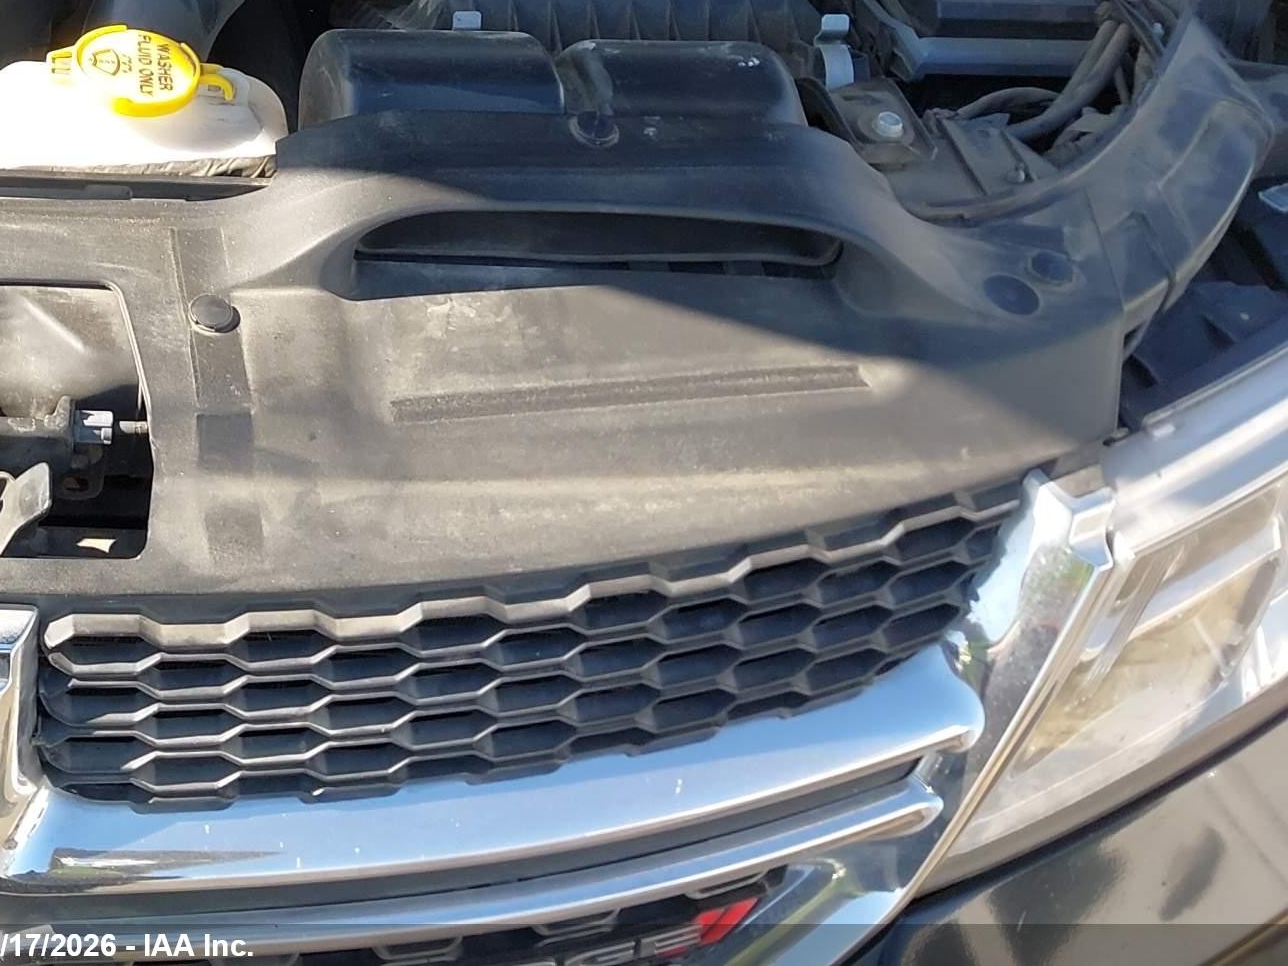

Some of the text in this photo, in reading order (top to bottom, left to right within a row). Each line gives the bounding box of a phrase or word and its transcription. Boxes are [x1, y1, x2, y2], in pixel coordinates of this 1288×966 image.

[138, 34, 154, 98] FLUID ONLY
[156, 43, 173, 91] WASHER
